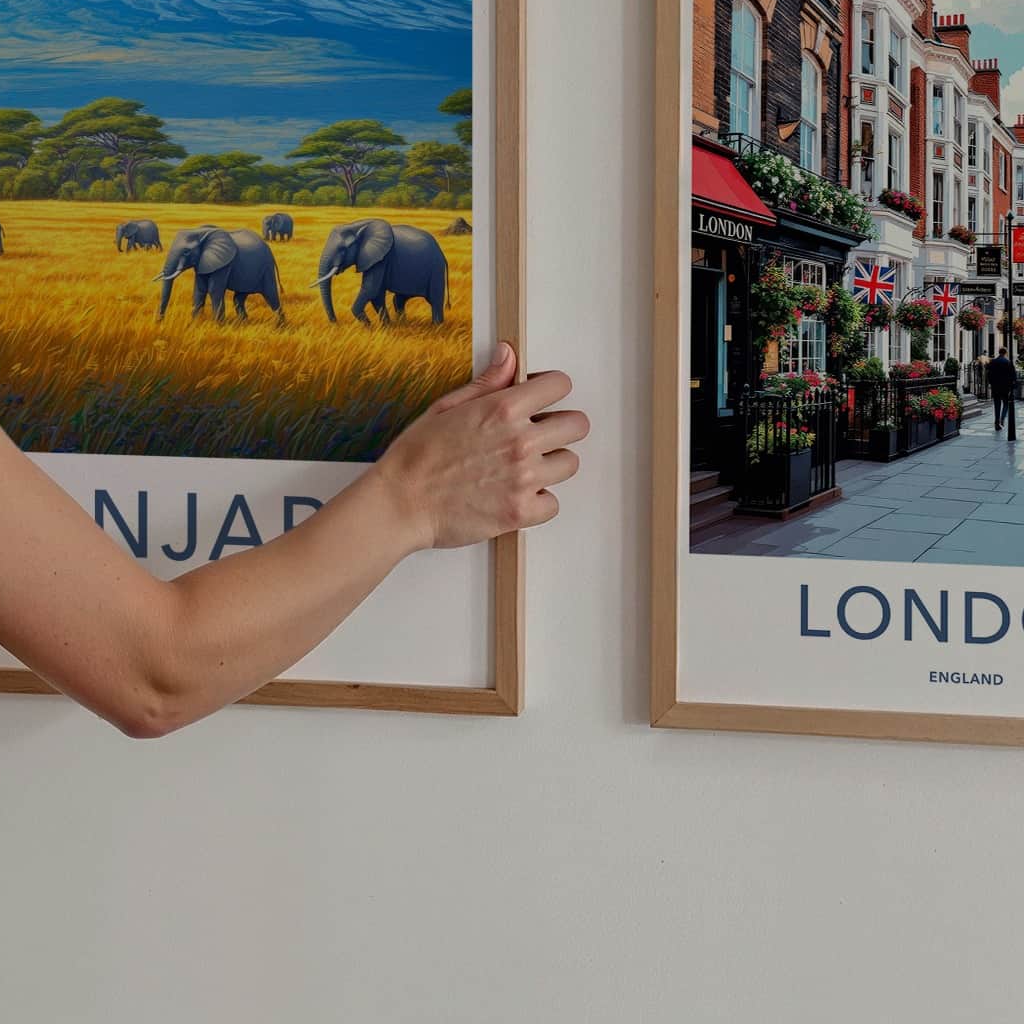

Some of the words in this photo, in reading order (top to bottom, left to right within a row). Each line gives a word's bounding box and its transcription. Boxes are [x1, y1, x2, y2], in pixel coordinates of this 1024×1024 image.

[698, 213, 753, 242] LONDON
[800, 584, 1024, 644] LOND
[929, 671, 1004, 686] ENGLAND
